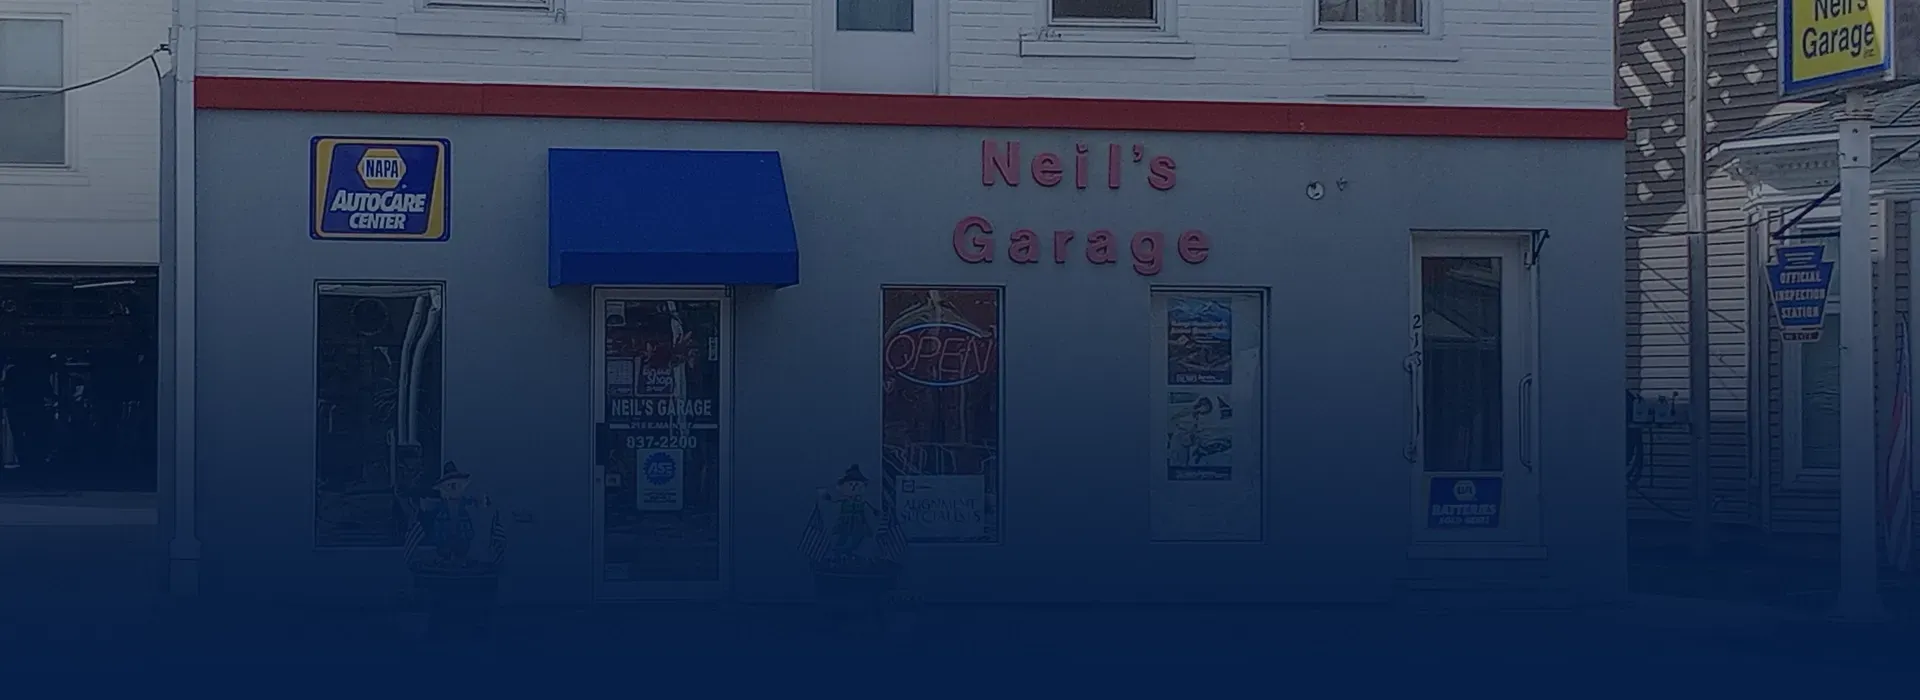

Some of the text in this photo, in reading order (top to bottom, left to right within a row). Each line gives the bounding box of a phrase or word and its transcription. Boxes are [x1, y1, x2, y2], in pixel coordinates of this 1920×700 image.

[1815, 0, 1868, 21] Neils
[1802, 20, 1875, 59] Garage
[366, 159, 398, 178] NAPA
[981, 140, 1177, 190] Neil's
[350, 212, 406, 229] CENTER
[953, 216, 1209, 276] Garage
[1780, 270, 1822, 284] OFFICIAL
[1775, 288, 1826, 301] INSPECTION
[1781, 306, 1819, 319] STATION
[886, 334, 993, 379] OPEN
[612, 399, 712, 416] NEIL'S GARAGE
[626, 436, 697, 448] 837-2200
[648, 462, 673, 475] ASE
